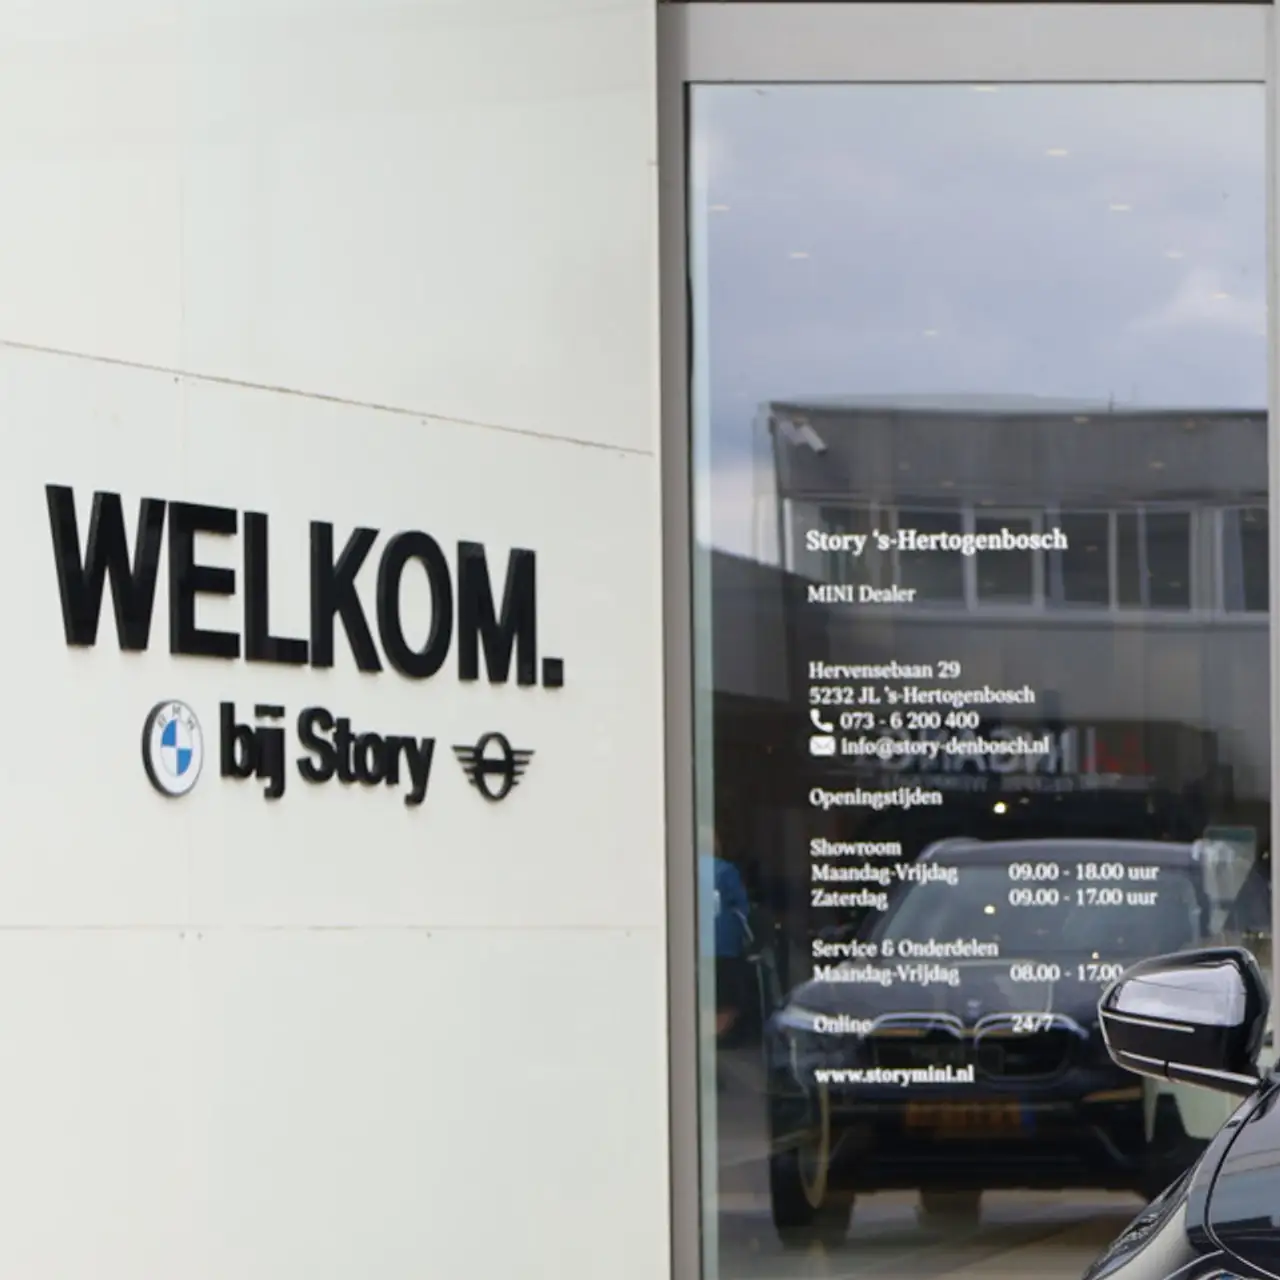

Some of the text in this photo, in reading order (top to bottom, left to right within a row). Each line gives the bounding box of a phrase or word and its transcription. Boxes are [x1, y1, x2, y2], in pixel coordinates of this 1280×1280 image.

[806, 527, 867, 557] Story
[45, 483, 565, 688] WELKOM.
[808, 584, 917, 604] MINI Dealer
[809, 660, 962, 680] Hervensebaan 29
[809, 685, 855, 705] 5232
[858, 686, 881, 705] JL
[840, 711, 878, 729] 073
[890, 711, 903, 729] 6
[906, 711, 942, 729] 200
[945, 711, 980, 729] 400
[296, 706, 436, 806] Story
[841, 735, 1051, 760] info@story-denbosch.nl
[809, 786, 943, 811] Openingstijden
[809, 838, 902, 857] Showroom
[811, 862, 959, 886] Maandag-Vrijdag
[1008, 862, 1060, 881] 09.00
[1076, 862, 1123, 881] 18.00
[1128, 867, 1160, 881] uur
[811, 888, 889, 911] Zaterdag
[1008, 887, 1060, 906] 09.00
[1076, 887, 1123, 906] 17.00
[1127, 892, 1159, 906] uur
[812, 938, 998, 958] Service & Onderdelen
[812, 963, 961, 987] Maandag-Vrijdag
[1010, 963, 1061, 982] 08.00
[1077, 963, 1124, 982] 17.00
[813, 1013, 1054, 1034] Online 24/7
[814, 1064, 975, 1087] www.storymini.nl
